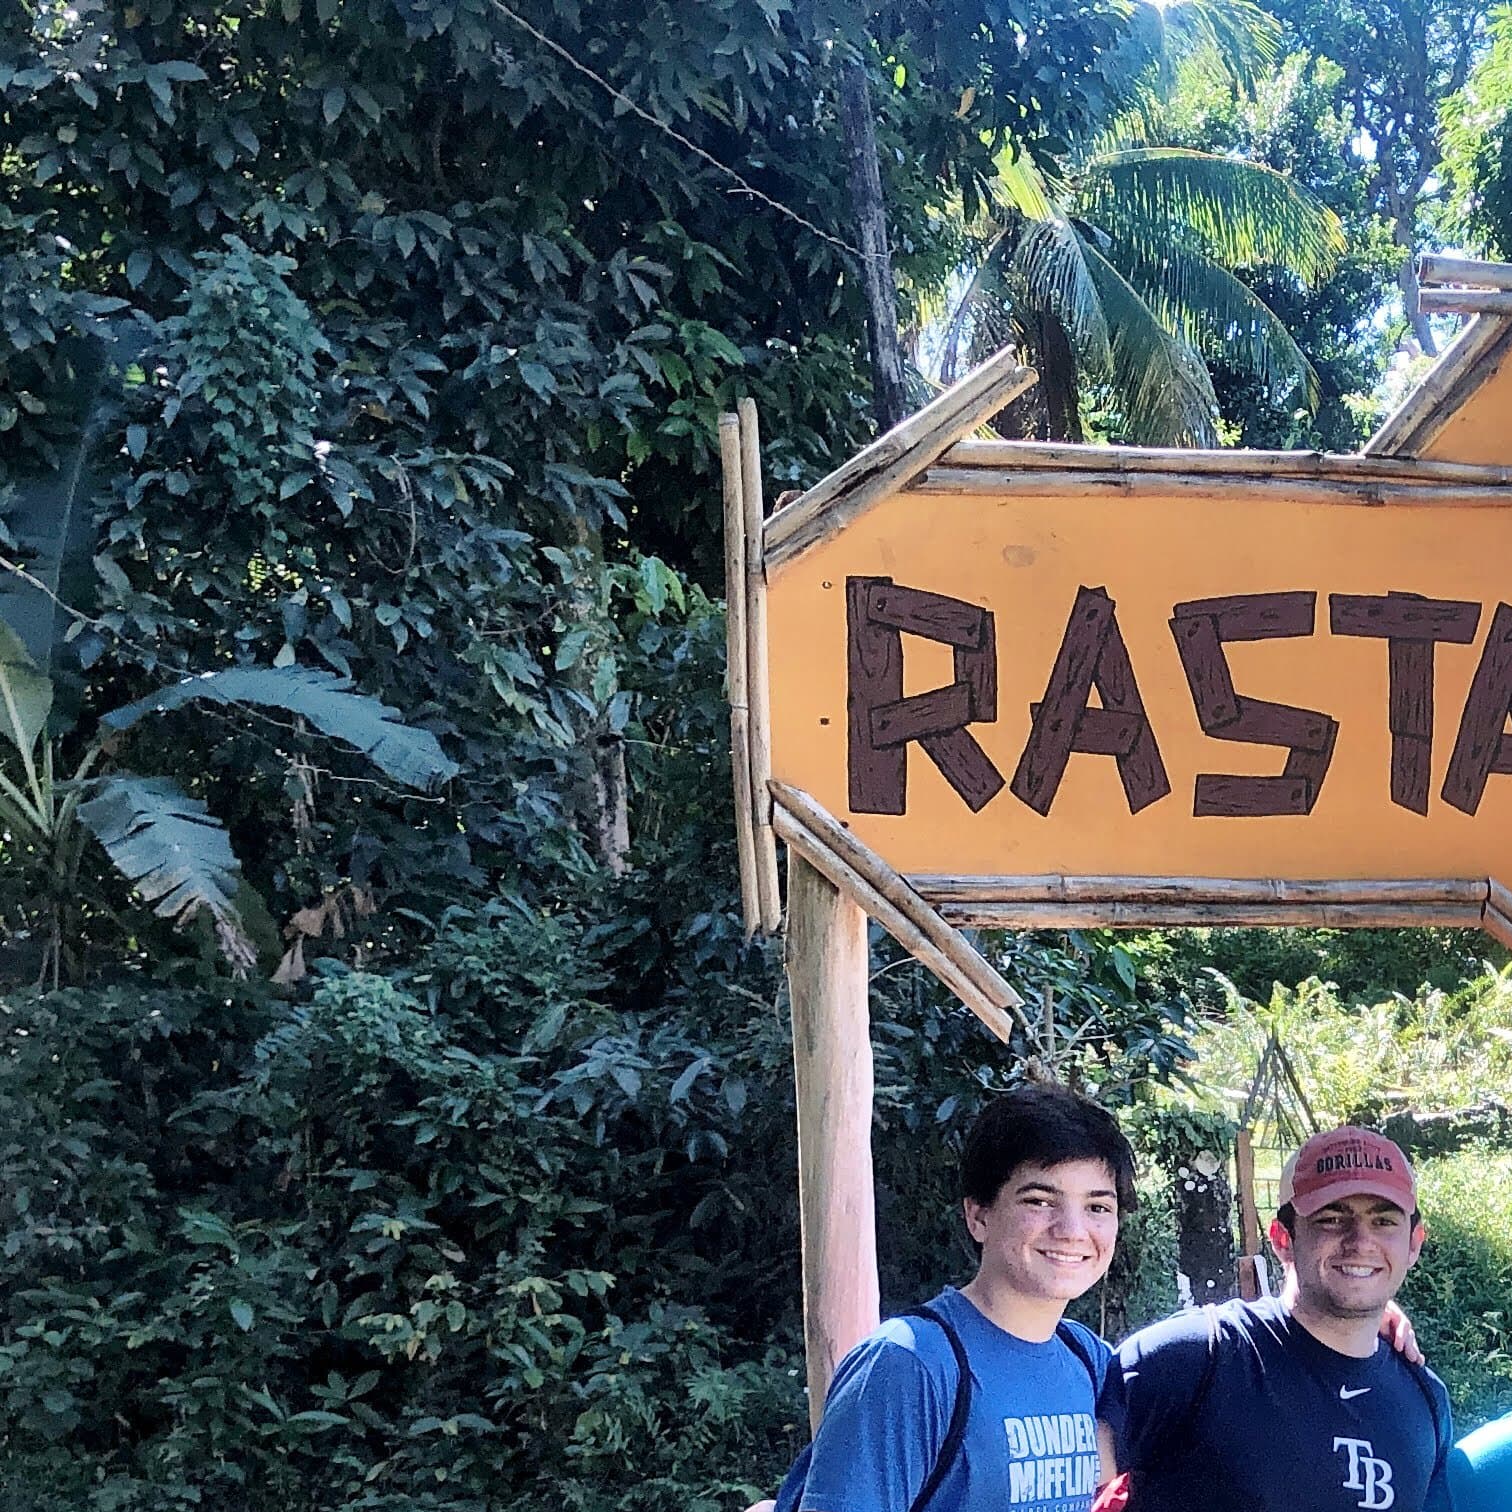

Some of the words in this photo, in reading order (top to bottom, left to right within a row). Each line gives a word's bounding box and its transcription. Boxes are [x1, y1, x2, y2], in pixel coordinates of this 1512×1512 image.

[1316, 1153, 1393, 1174] GORILLAS
[1004, 1413, 1098, 1459] DUNDER
[1009, 1455, 1096, 1504] MIFFLIN
[1332, 1436, 1395, 1510] TB
